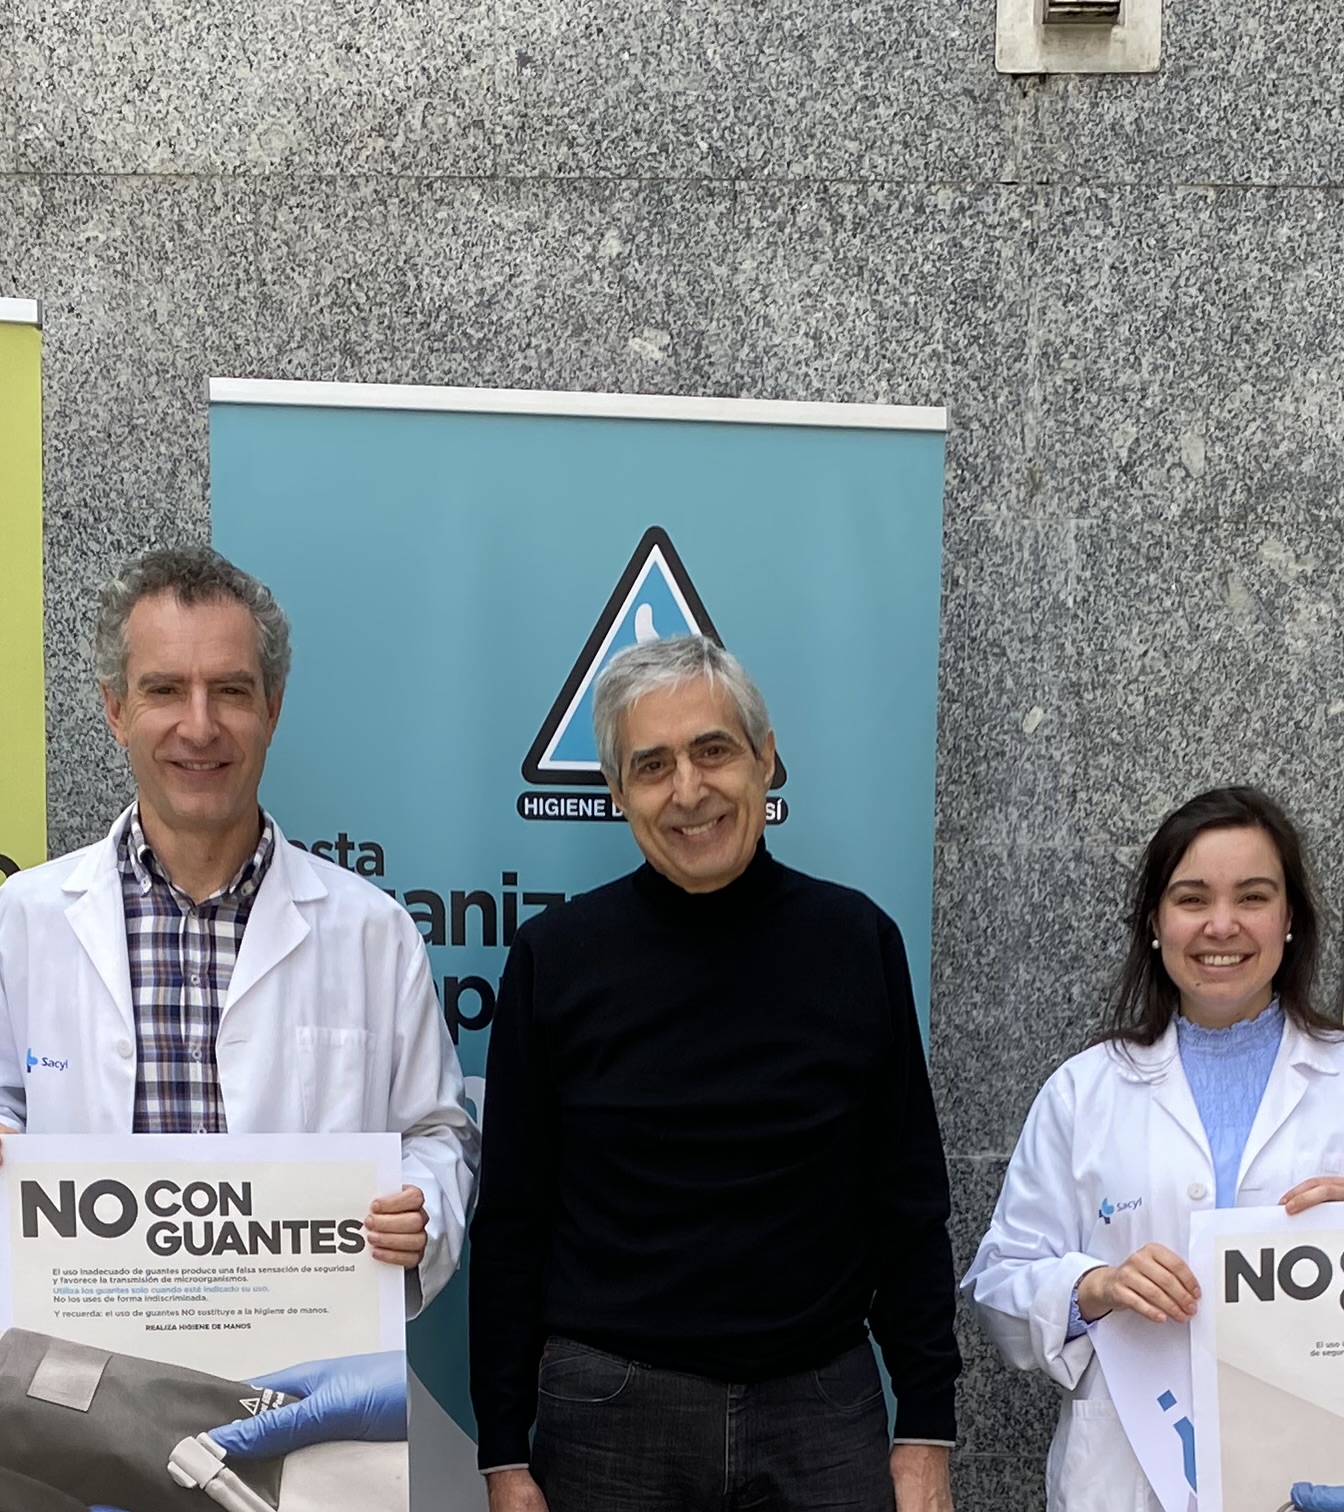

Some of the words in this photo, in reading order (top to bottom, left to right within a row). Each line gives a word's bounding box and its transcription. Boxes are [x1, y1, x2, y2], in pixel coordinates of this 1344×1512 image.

[524, 798, 605, 816] HIGIENE
[41, 1057, 68, 1071] Sacyl
[20, 1179, 138, 1239] NO
[144, 1180, 252, 1217] CON
[1117, 1197, 1143, 1212] Sacyl
[146, 1219, 366, 1256] GUANTES
[80, 1267, 130, 1275] inadecuado
[145, 1266, 179, 1277] guantes
[181, 1266, 216, 1276] produce
[258, 1265, 299, 1273] sensación
[301, 1265, 311, 1273] de
[314, 1265, 355, 1275] seguridad
[1225, 1245, 1333, 1303] NO
[110, 1275, 158, 1283] transmisión
[161, 1275, 172, 1283] de
[54, 1294, 66, 1302] No
[68, 1294, 80, 1302] los
[104, 1294, 114, 1302] de
[117, 1294, 142, 1302] forma
[146, 1308, 179, 1318] guantes
[198, 1308, 235, 1318] sustituye
[244, 1307, 252, 1315] la
[254, 1307, 284, 1317] higiene
